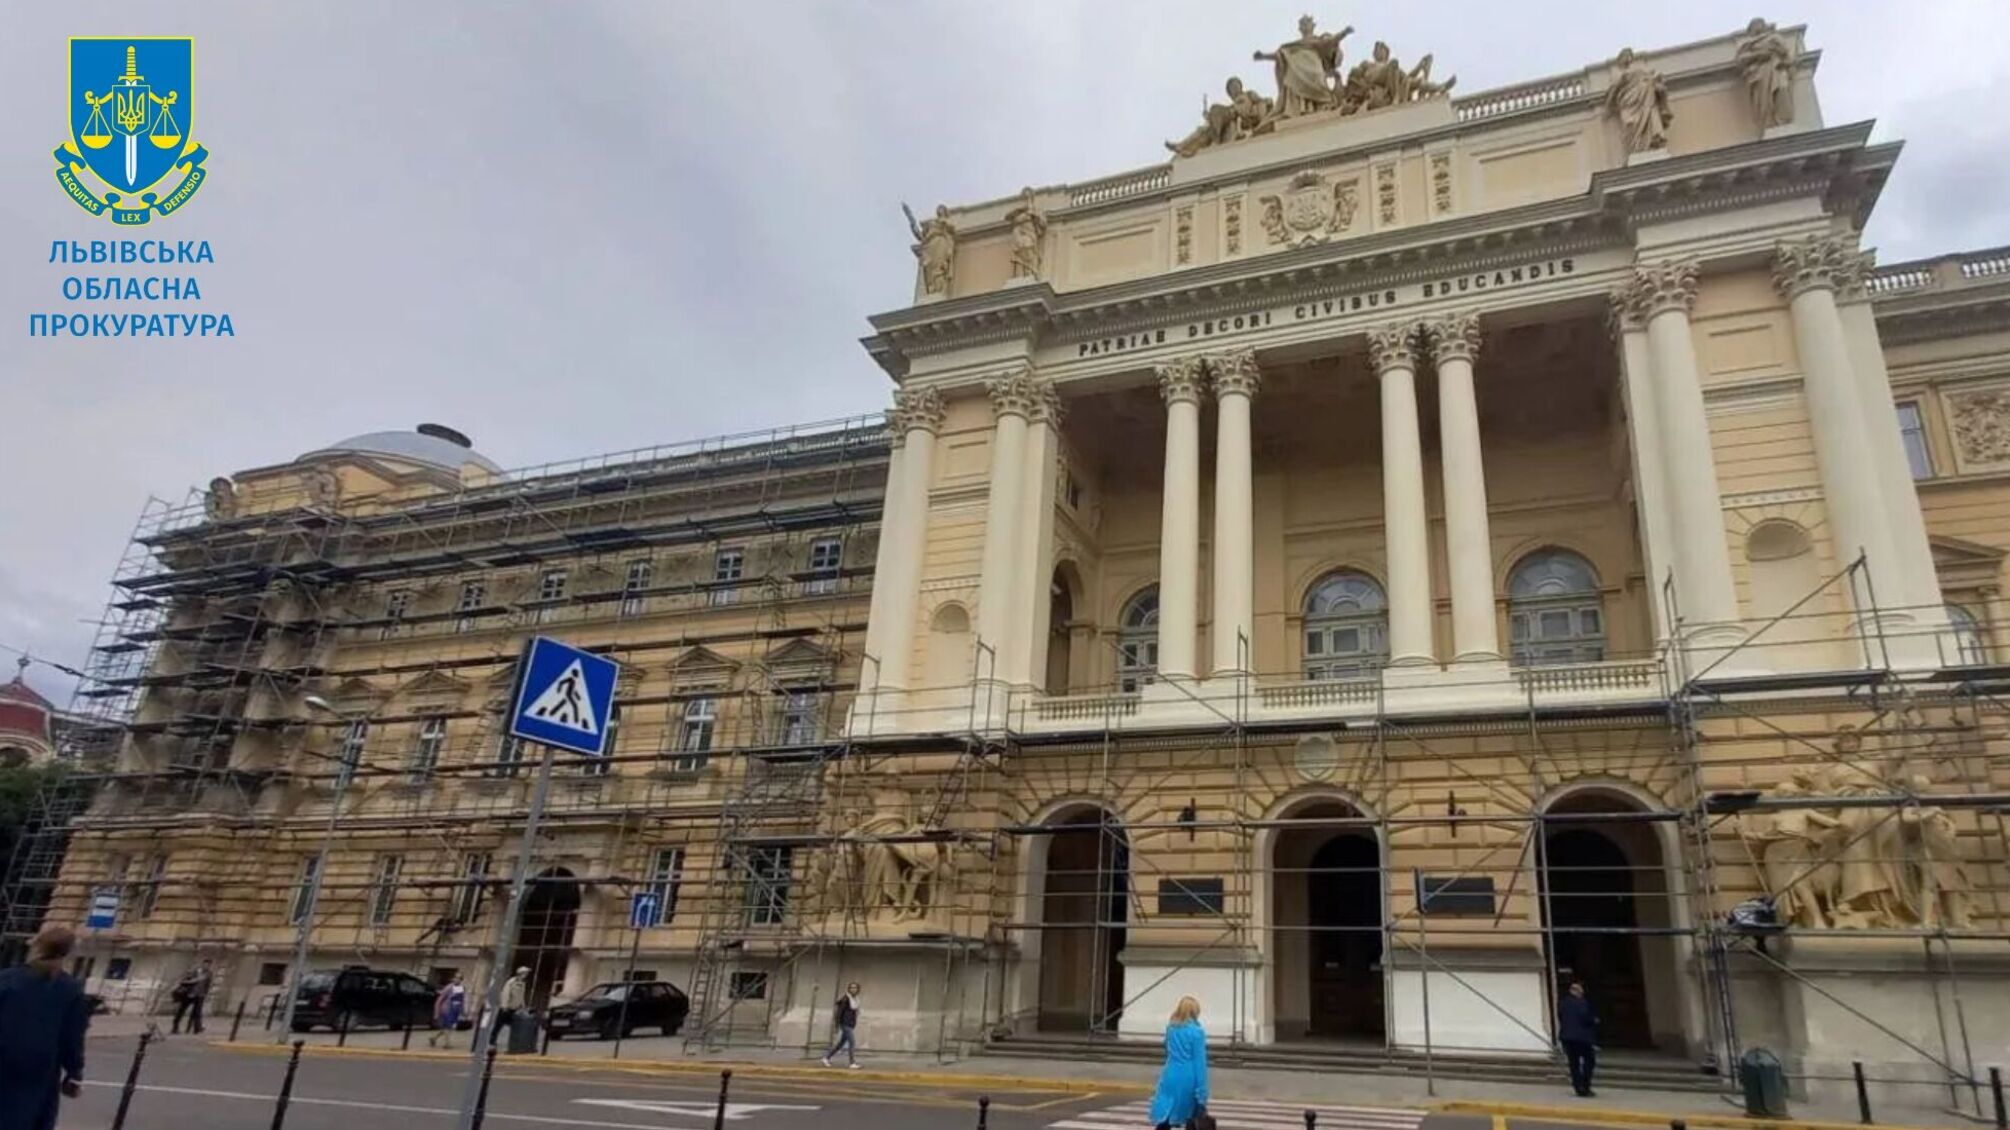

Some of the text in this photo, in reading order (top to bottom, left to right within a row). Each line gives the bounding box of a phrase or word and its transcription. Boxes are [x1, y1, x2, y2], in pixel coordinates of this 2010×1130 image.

[1079, 259, 1574, 357] PATRIAE DECORI CIVIBUS EDUCANDIS
